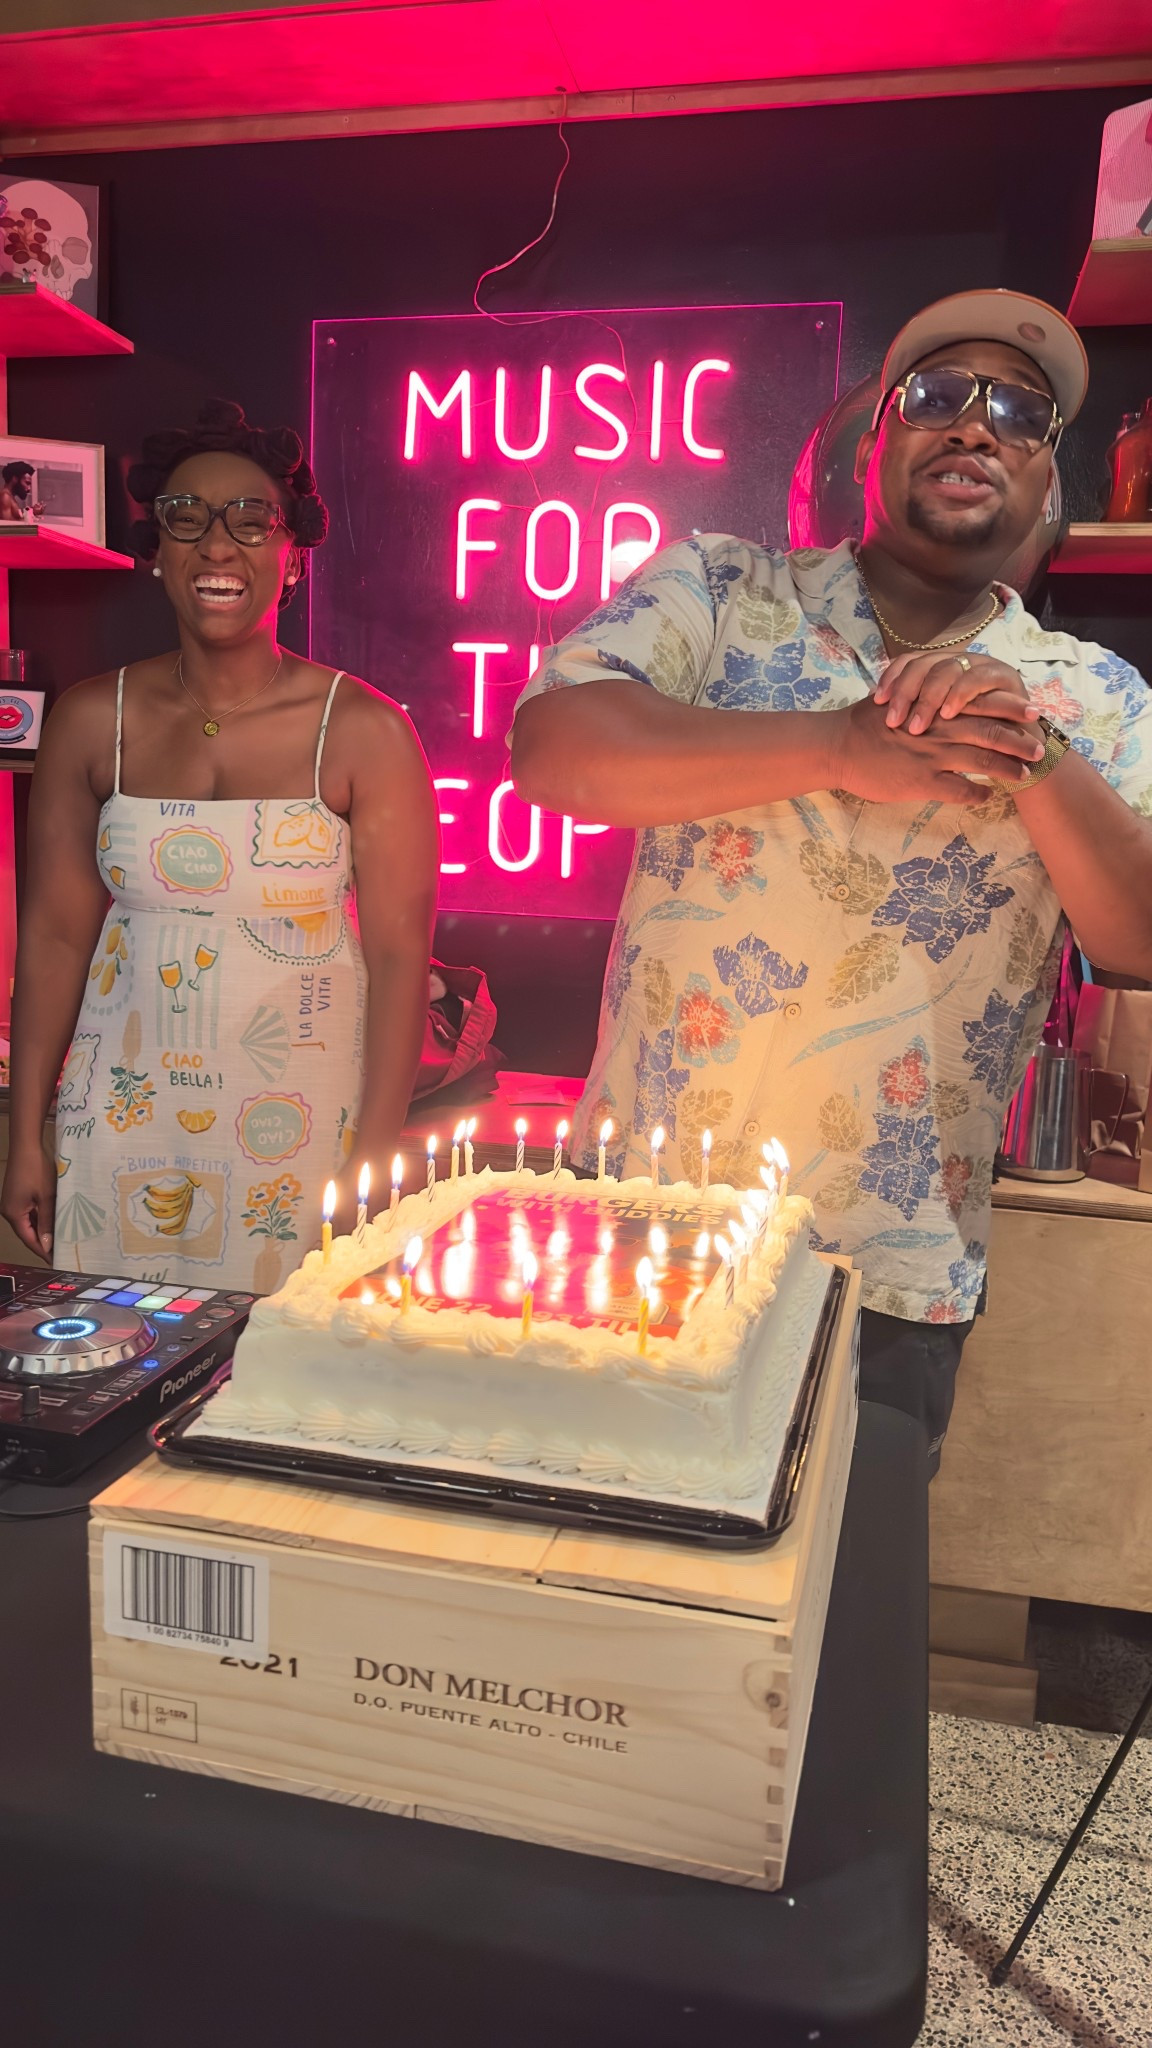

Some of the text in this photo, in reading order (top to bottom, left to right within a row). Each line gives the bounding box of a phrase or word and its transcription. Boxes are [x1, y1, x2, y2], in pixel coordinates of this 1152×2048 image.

[403, 358, 730, 462] MUSIC
[160, 801, 196, 817] VITA
[167, 844, 208, 860] CIAO
[184, 862, 218, 875] CIAO
[262, 882, 326, 902] Limone
[317, 976, 332, 1012] VITA
[299, 973, 315, 1039] LA DOLCE
[161, 1051, 203, 1069] CIAO
[251, 1115, 282, 1129] CIAO
[258, 1129, 295, 1144] CIAO
[495, 1199, 723, 1226] WITH BUDDIES
[501, 1187, 727, 1216] BURGERS
[159, 1352, 217, 1404] Pioneer
[165, 1629, 193, 1641] 82734
[353, 1656, 630, 1728] DON MELCHOR
[353, 1692, 393, 1711] D.O.
[400, 1701, 482, 1727] PUENTE
[488, 1718, 542, 1738] ALTO
[562, 1731, 629, 1754] CHILE
